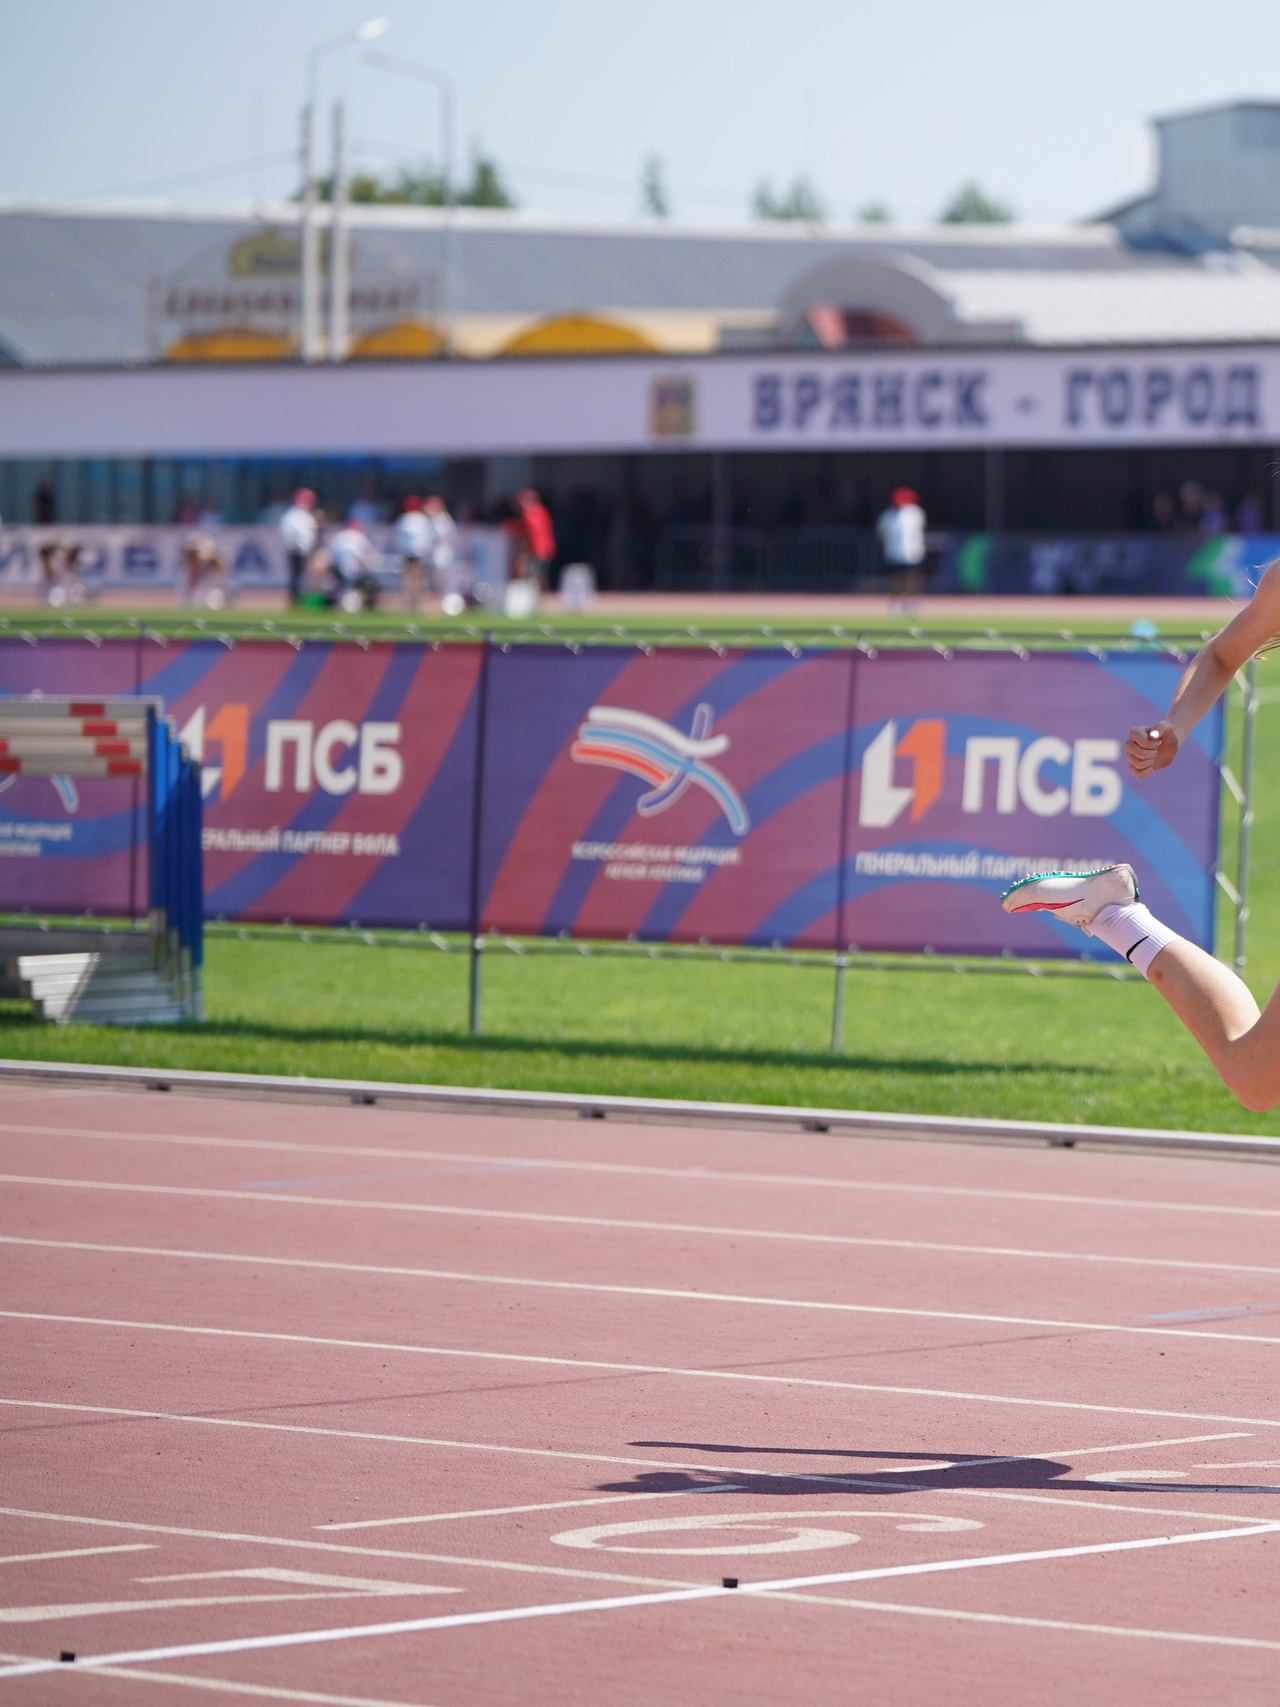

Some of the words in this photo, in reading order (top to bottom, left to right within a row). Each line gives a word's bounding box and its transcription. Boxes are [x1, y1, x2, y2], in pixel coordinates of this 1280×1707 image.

[752, 367, 990, 431] БРЯНСК
[1063, 362, 1264, 428] ГОРОД
[265, 719, 403, 795] ПСБ
[962, 736, 1123, 817] ПСБ
[202, 825, 280, 853] ЕРАЛЬНЫЙ
[283, 830, 351, 855] ПАРТНЕР
[855, 850, 978, 879] ГЕНЕРАЛЬНЫЙ
